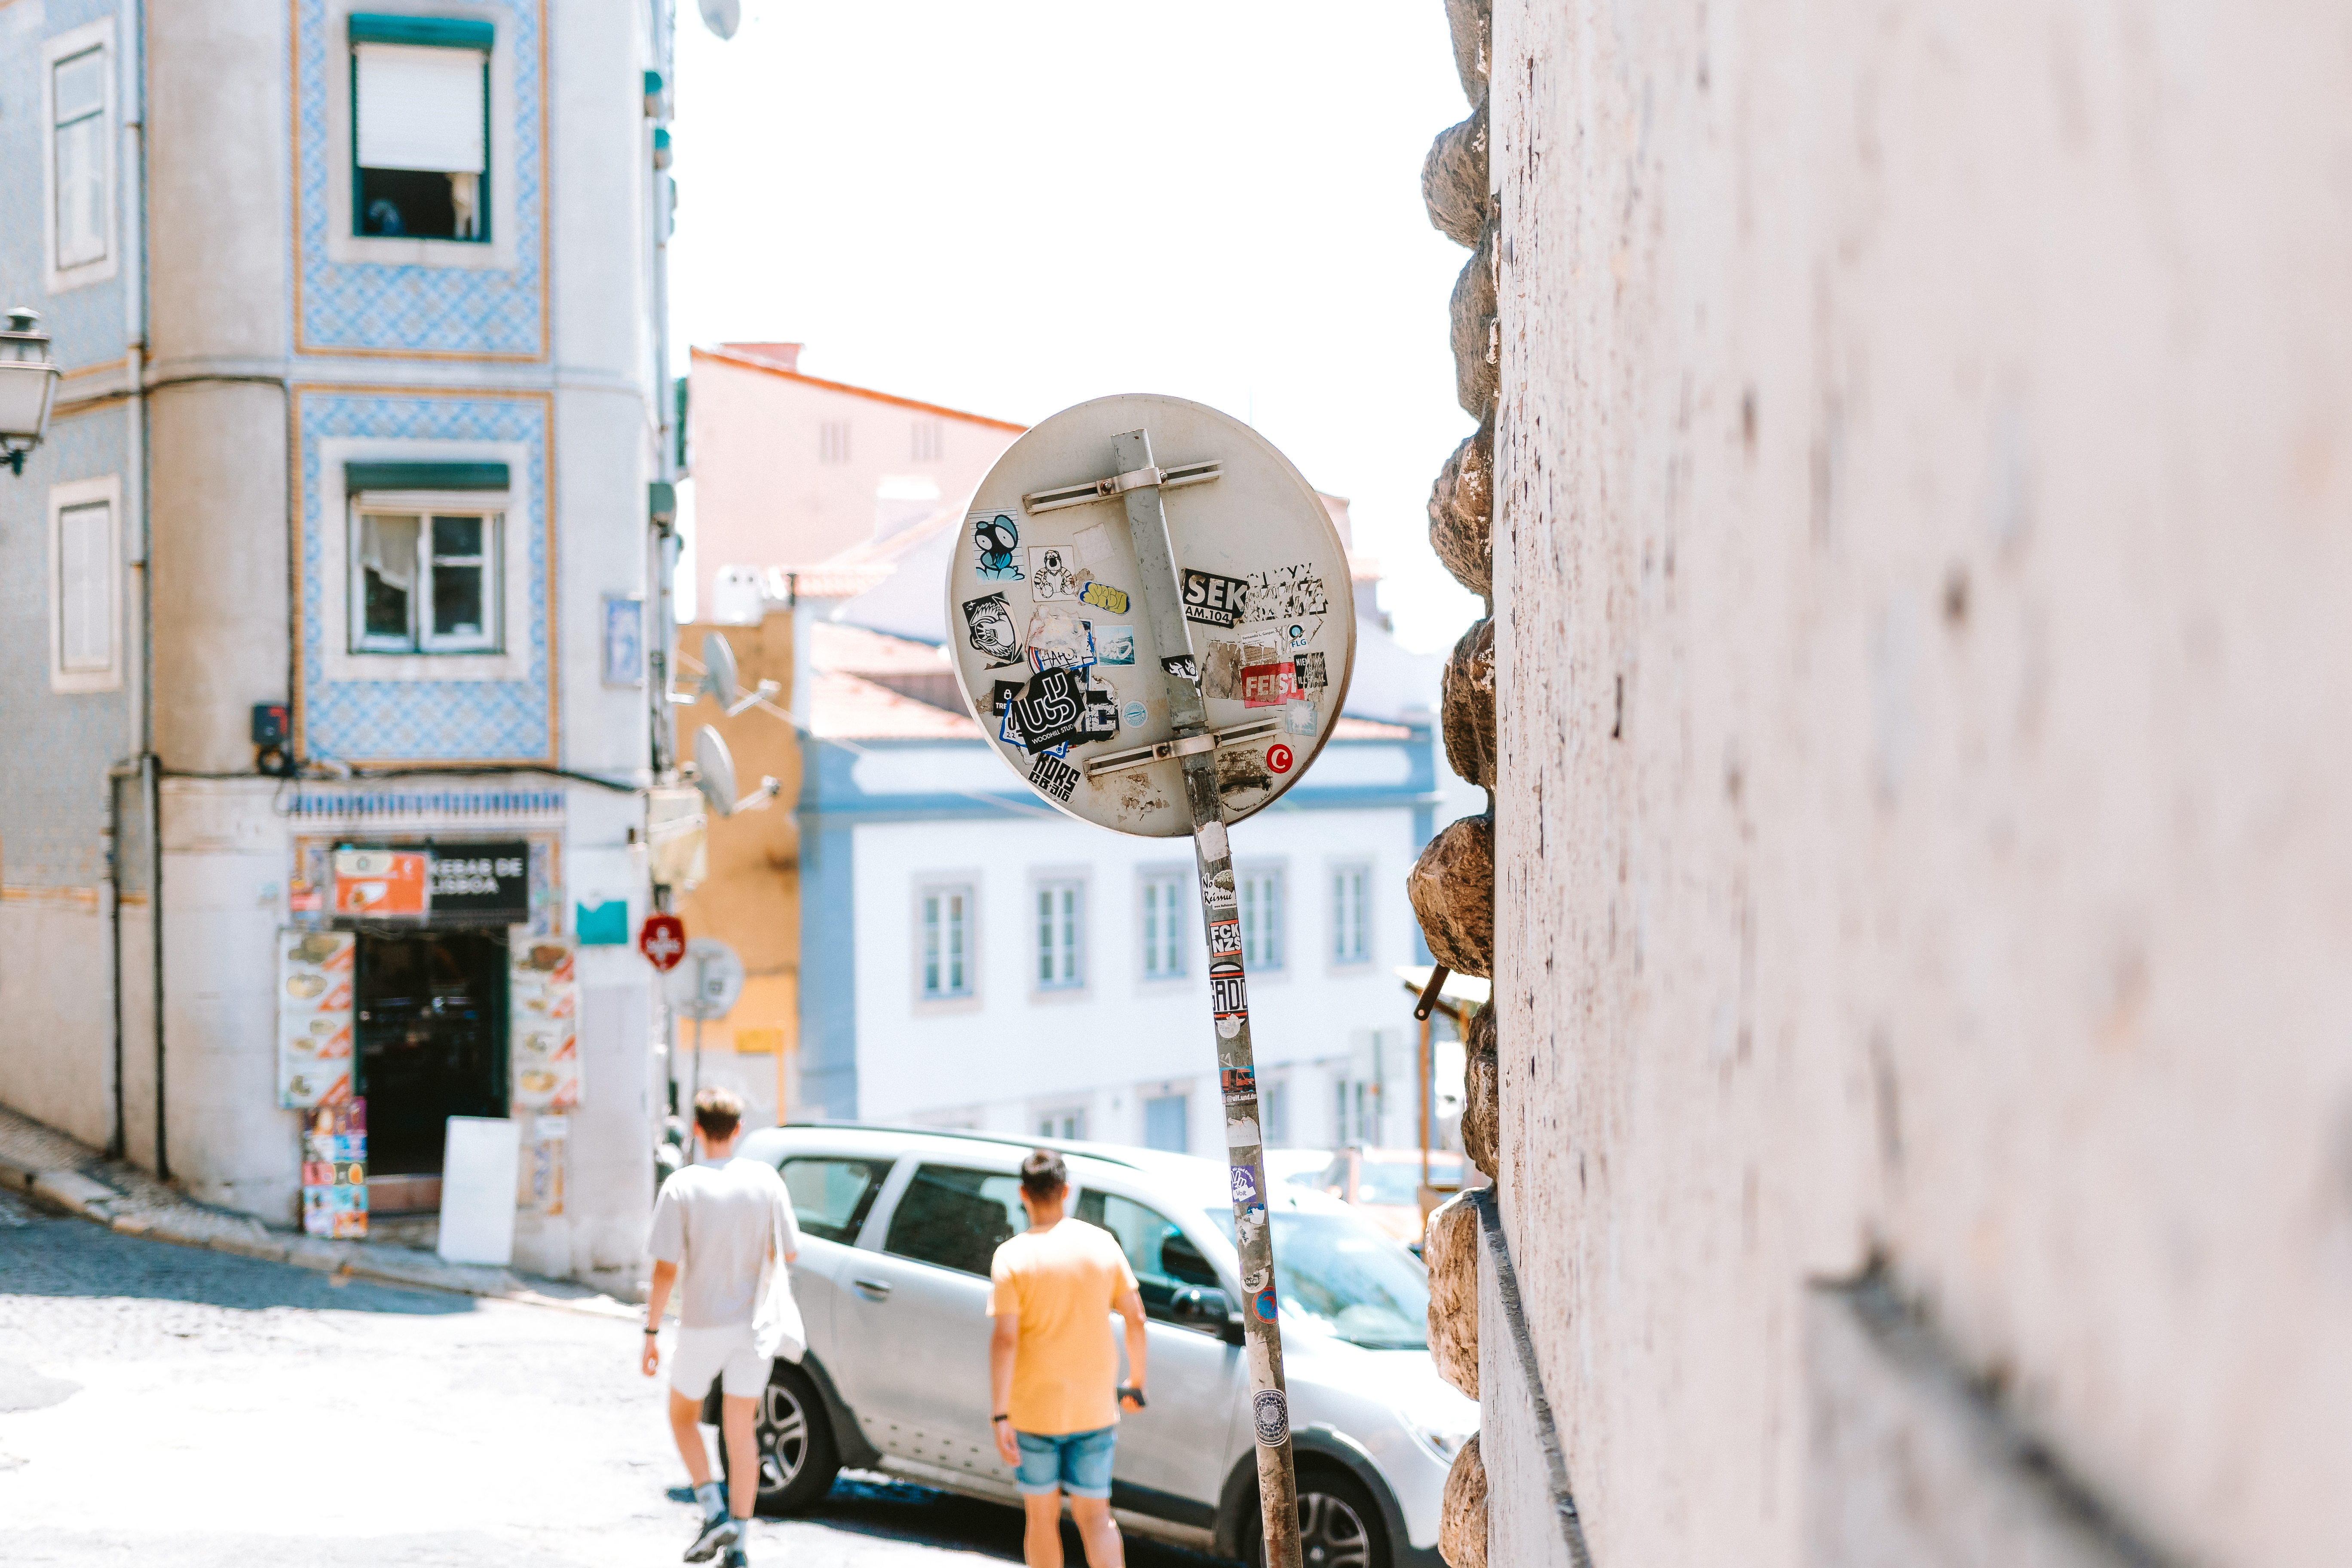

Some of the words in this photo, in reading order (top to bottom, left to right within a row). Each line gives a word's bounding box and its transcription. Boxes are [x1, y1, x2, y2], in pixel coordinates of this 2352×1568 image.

[1291, 639, 1306, 647] FLG
[1246, 673, 1297, 697] FEIST
[1032, 729, 1060, 744] WOODHILL
[1062, 723, 1075, 732] STUD
[495, 858, 523, 877] DE
[1210, 923, 1240, 940] FCK
[1212, 937, 1241, 953] NZS
